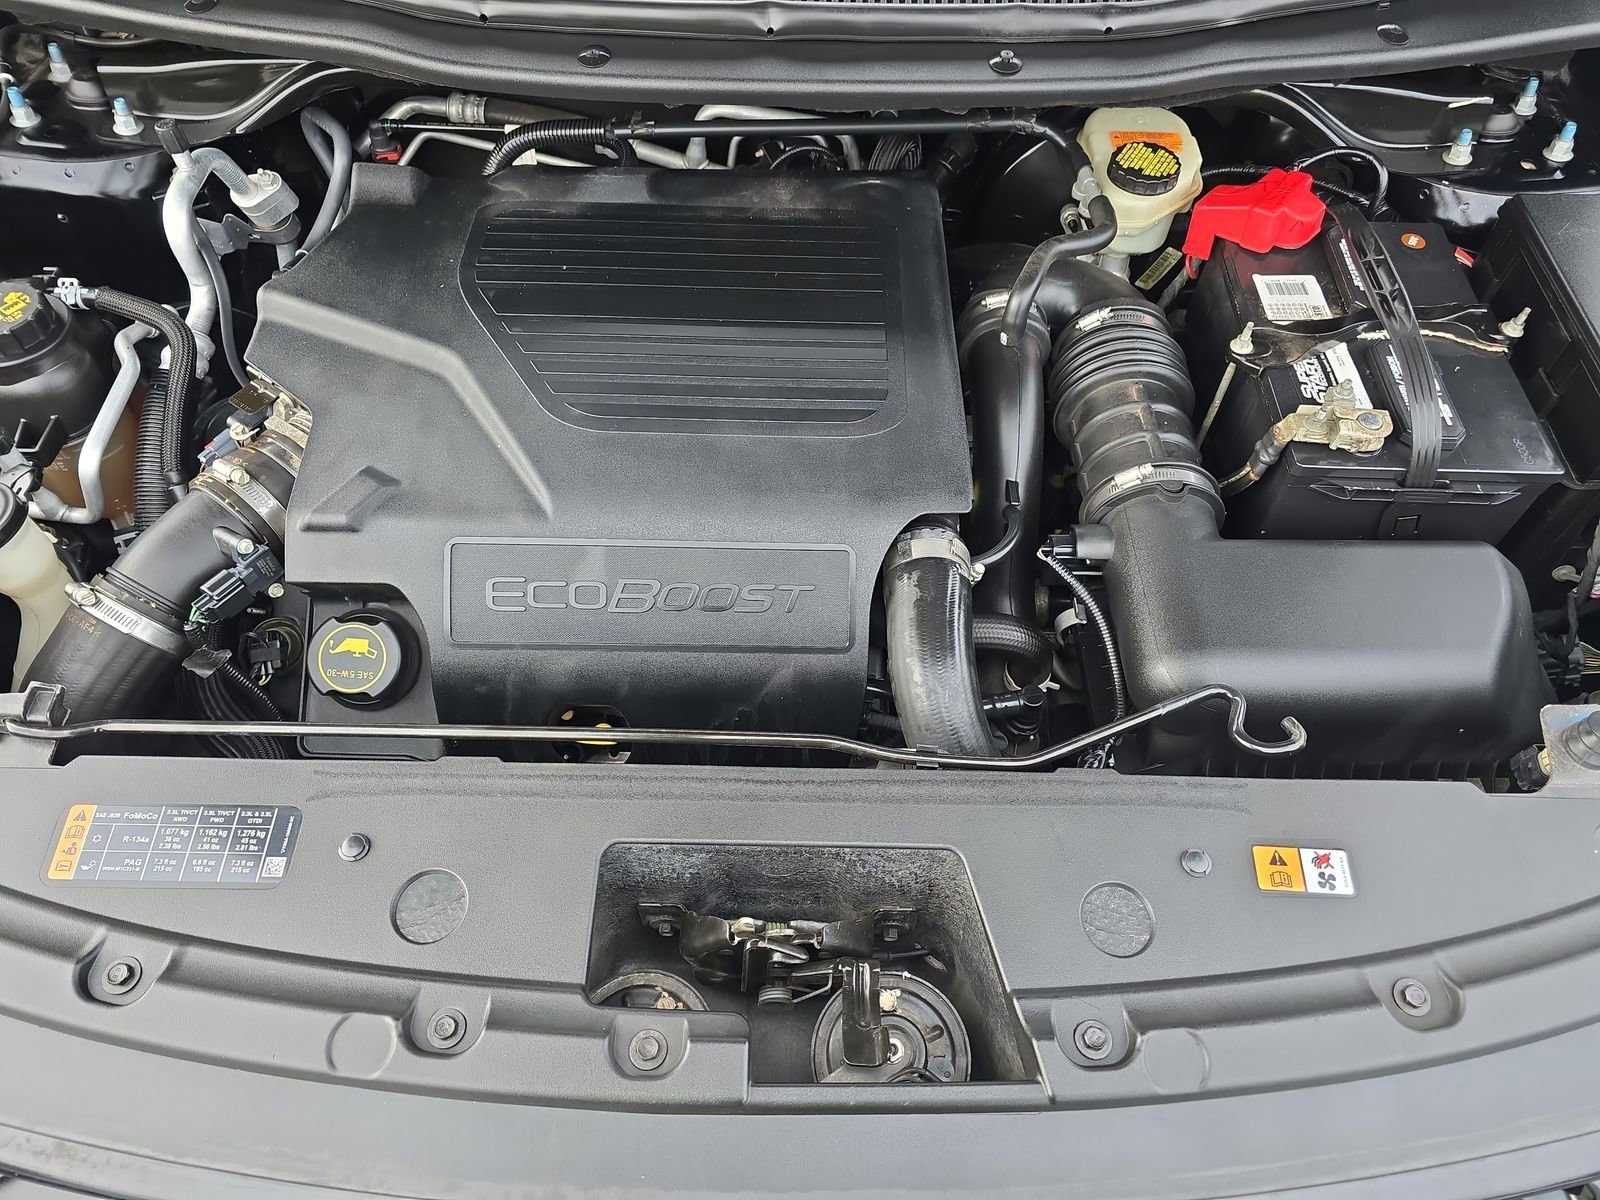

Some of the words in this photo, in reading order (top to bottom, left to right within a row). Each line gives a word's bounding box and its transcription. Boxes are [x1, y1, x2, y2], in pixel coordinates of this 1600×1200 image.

[1386, 356, 1403, 379] POISON
[1292, 362, 1314, 398] SUPE
[327, 669, 355, 678] 5W-30
[357, 671, 374, 679] SAE
[123, 811, 159, 820] FoMoCo
[180, 829, 189, 837] kg
[217, 829, 228, 837] kg
[256, 830, 266, 839] kg
